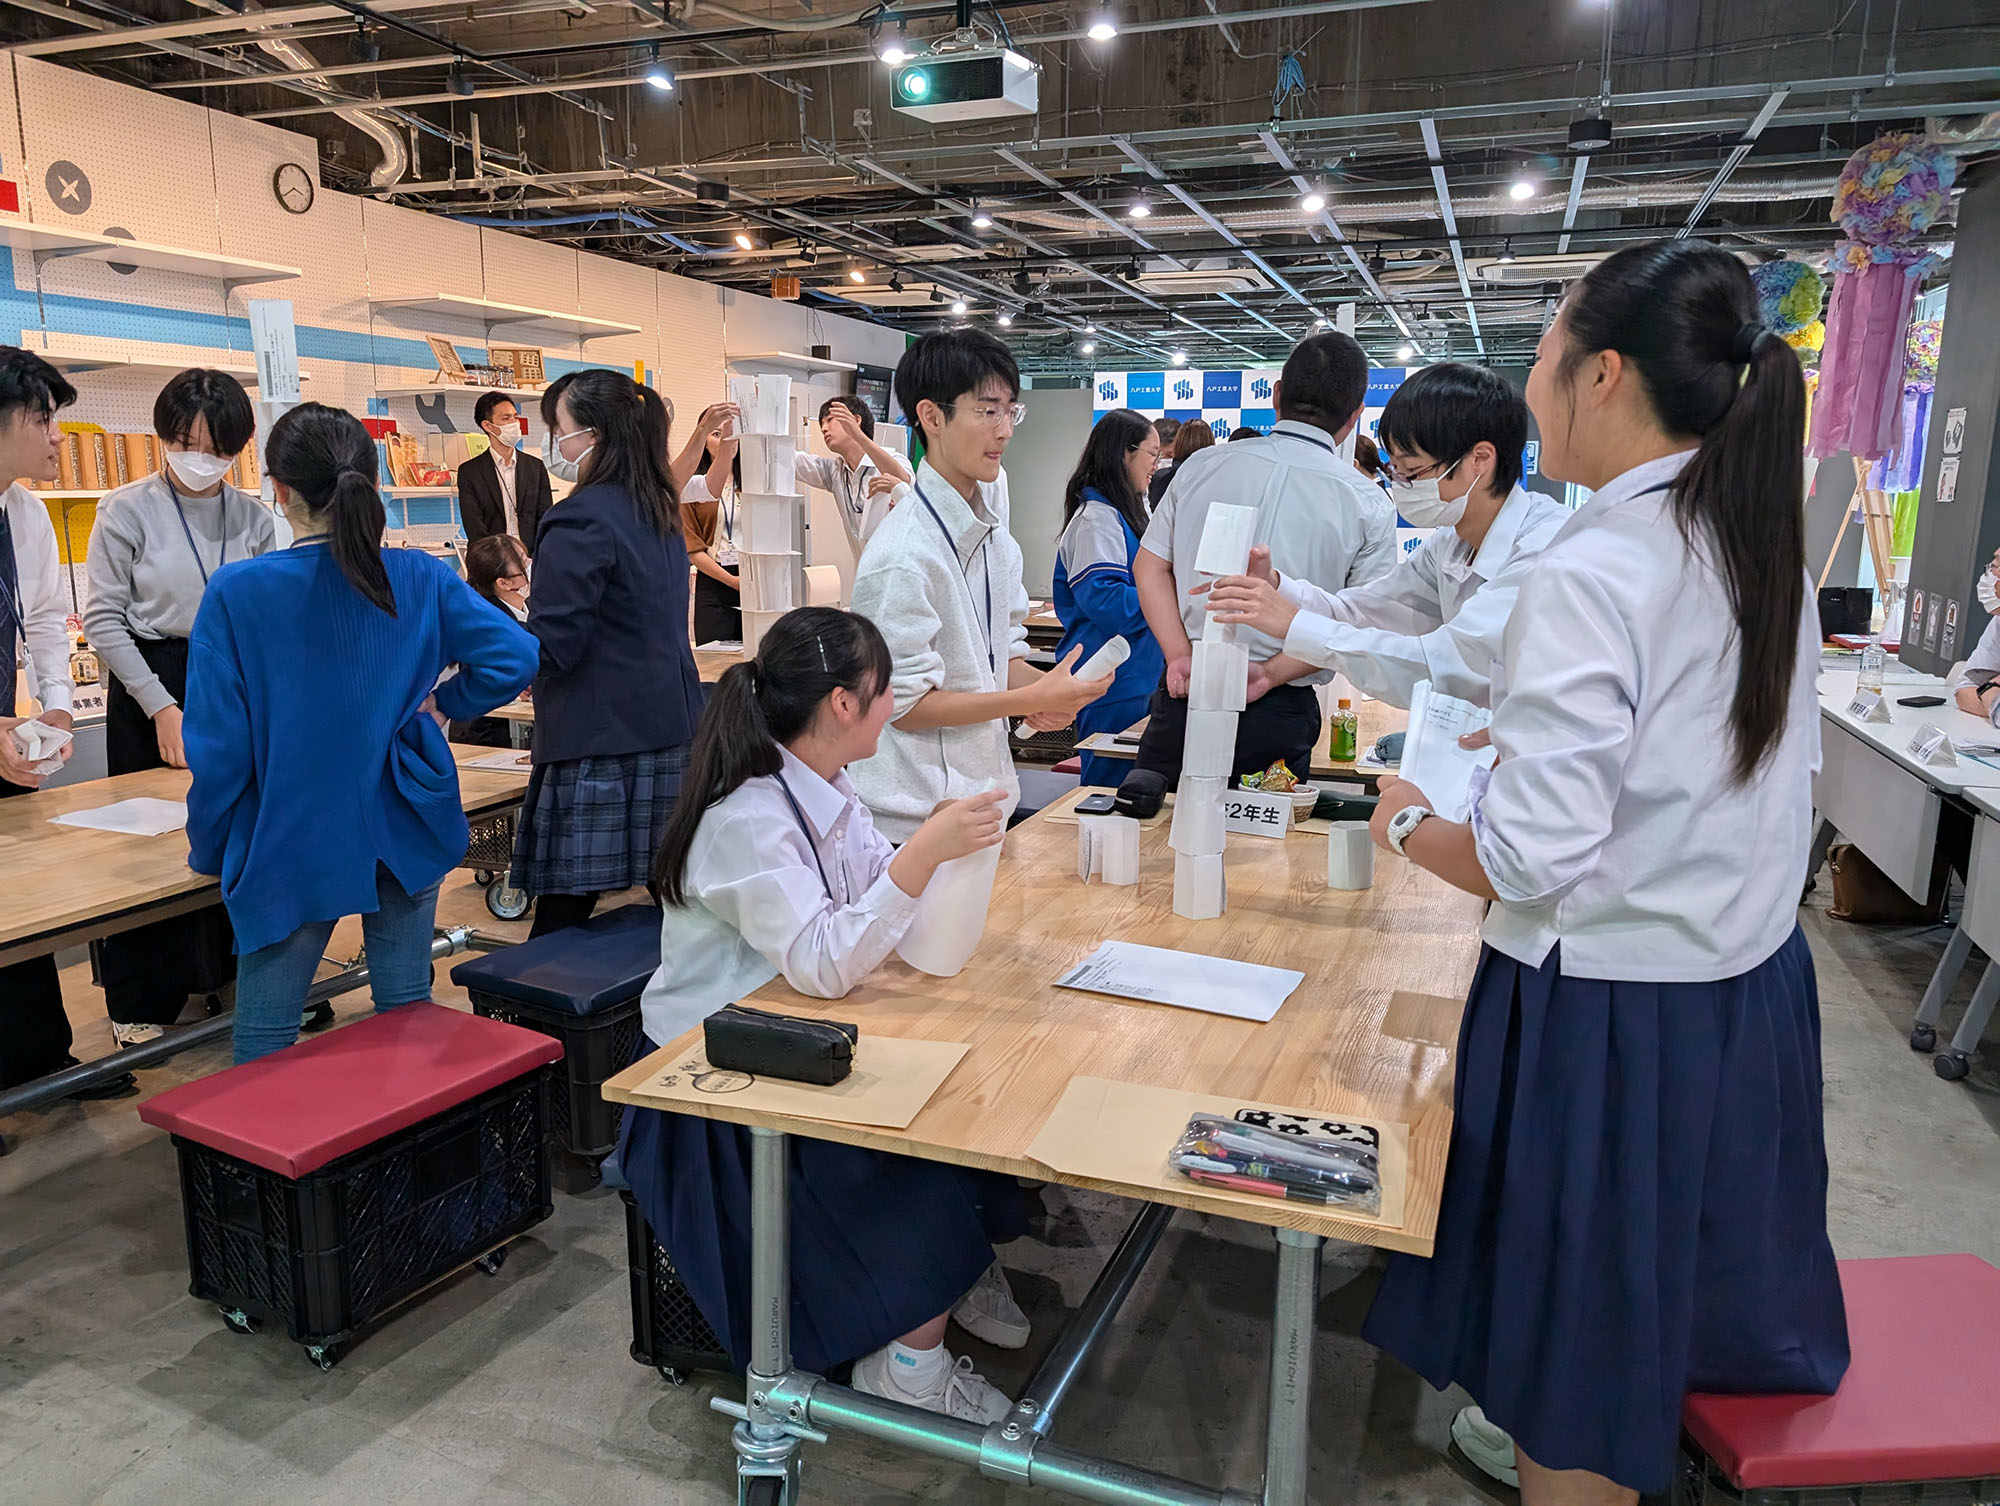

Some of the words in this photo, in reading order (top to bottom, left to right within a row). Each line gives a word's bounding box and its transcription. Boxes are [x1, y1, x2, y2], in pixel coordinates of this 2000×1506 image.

[73, 696, 103, 710] 事業者
[1225, 803, 1280, 825] 2年生
